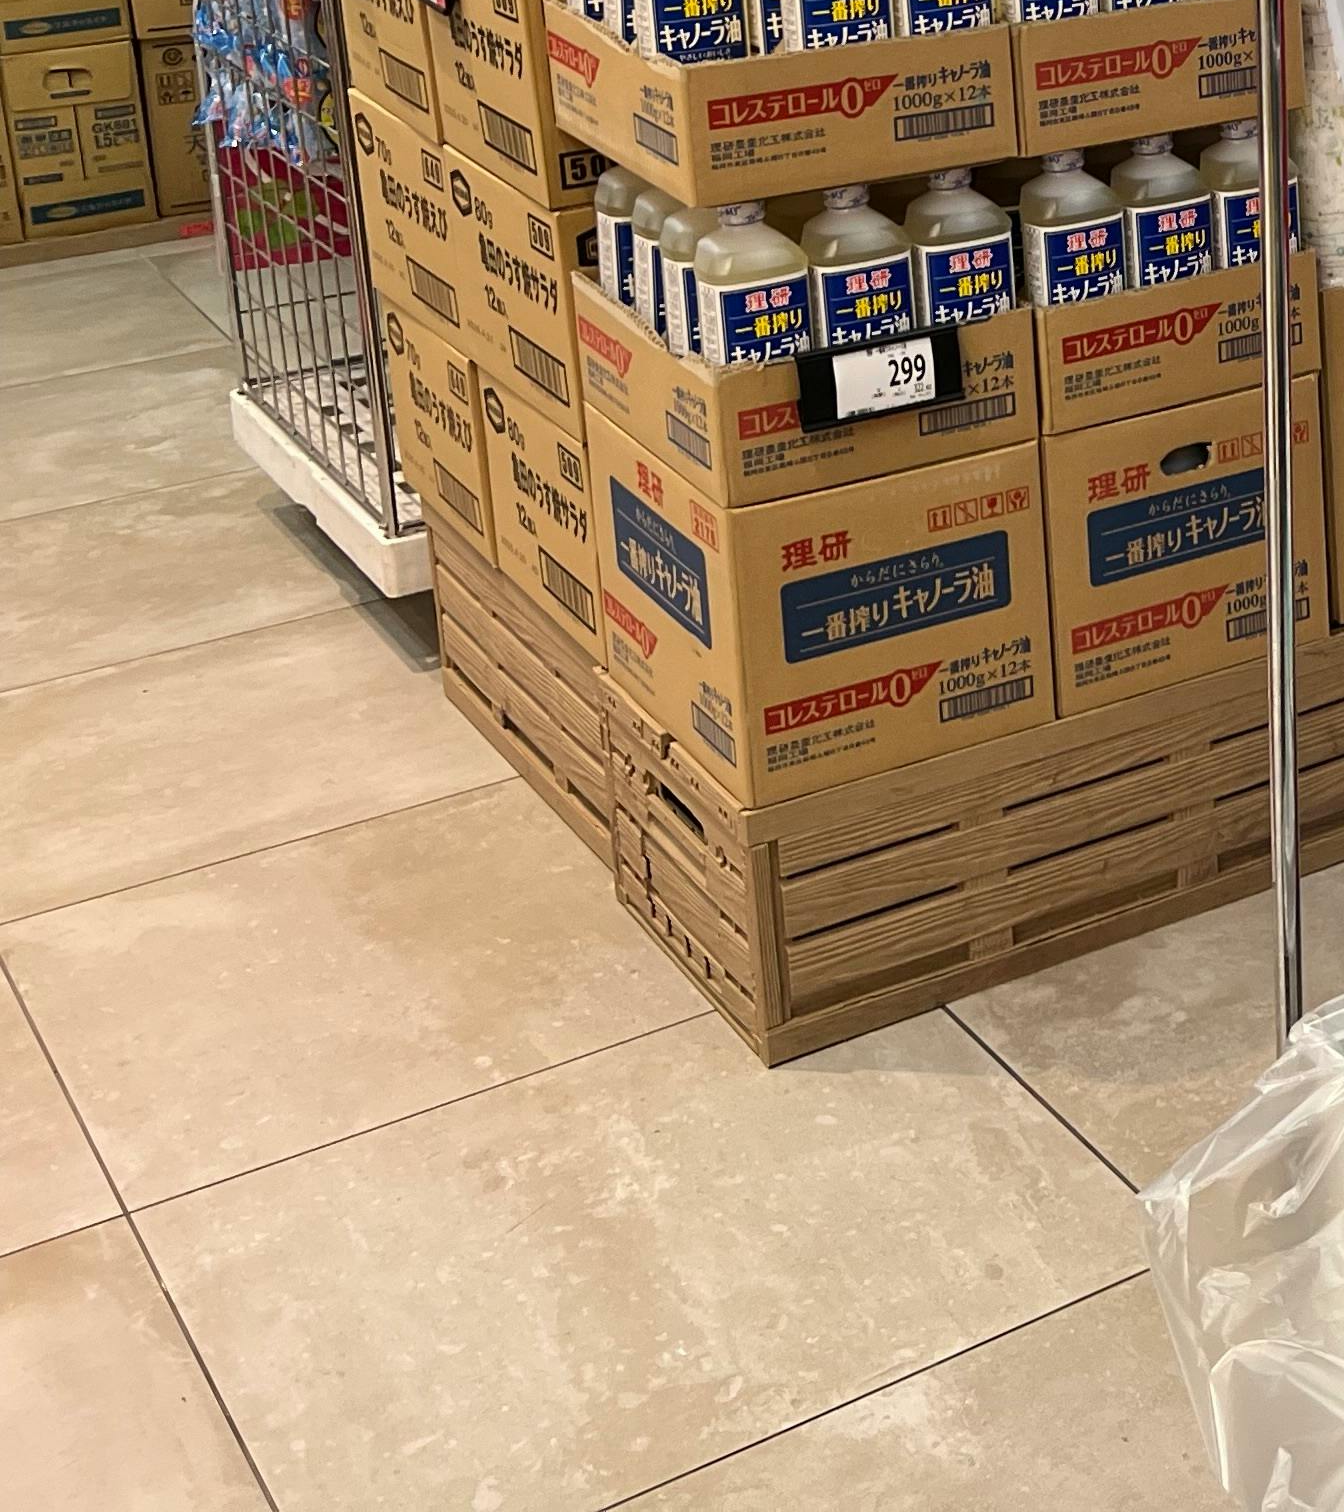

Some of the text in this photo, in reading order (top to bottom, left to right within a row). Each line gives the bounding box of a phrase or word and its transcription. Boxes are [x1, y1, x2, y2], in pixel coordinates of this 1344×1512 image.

[660, 15, 742, 52] キャノーラ油
[807, 19, 888, 48] キャノーラ油
[913, 4, 991, 35] キャノーラ油
[893, 85, 992, 111] 1000g×12本
[531, 220, 550, 251] 509
[479, 232, 558, 315] 亀田のうす焼サラダ
[888, 354, 927, 388] 299
[561, 451, 580, 483] 509
[511, 452, 588, 543] 亀田のうす焼サラダ
[801, 563, 996, 641] 一番搾りキャノーラ油
[939, 658, 1032, 696] 1000g×12本
